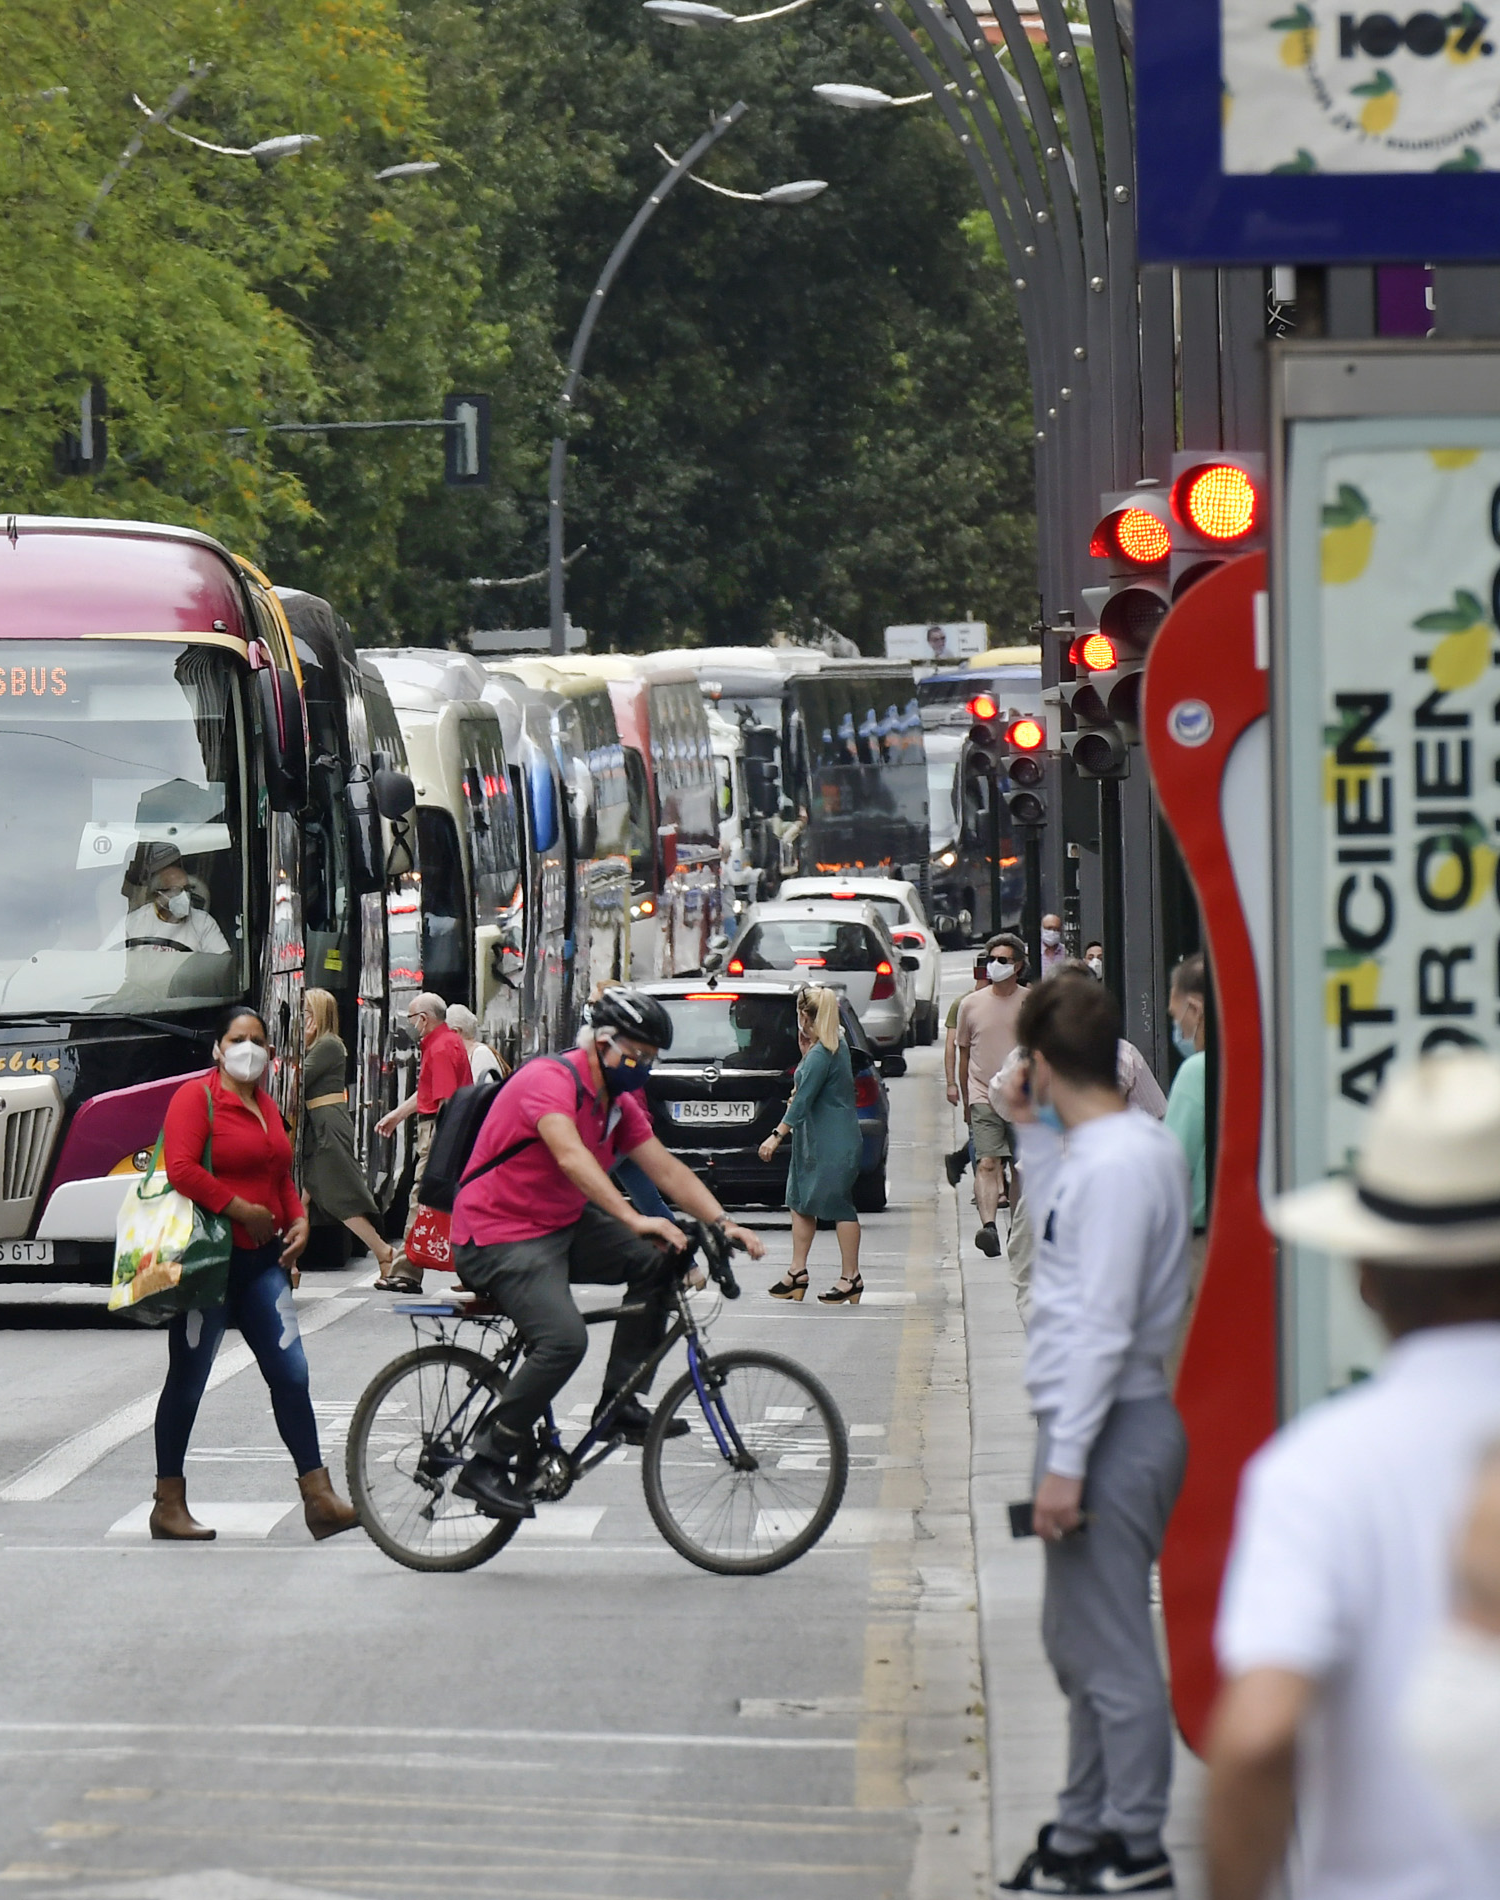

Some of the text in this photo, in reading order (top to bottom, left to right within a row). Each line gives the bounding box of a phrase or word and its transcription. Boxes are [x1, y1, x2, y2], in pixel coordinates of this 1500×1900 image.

[1335, 693, 1393, 954] CIEN
[683, 1104, 750, 1117] 8495 JYR
[12, 1243, 46, 1261] GTJ
